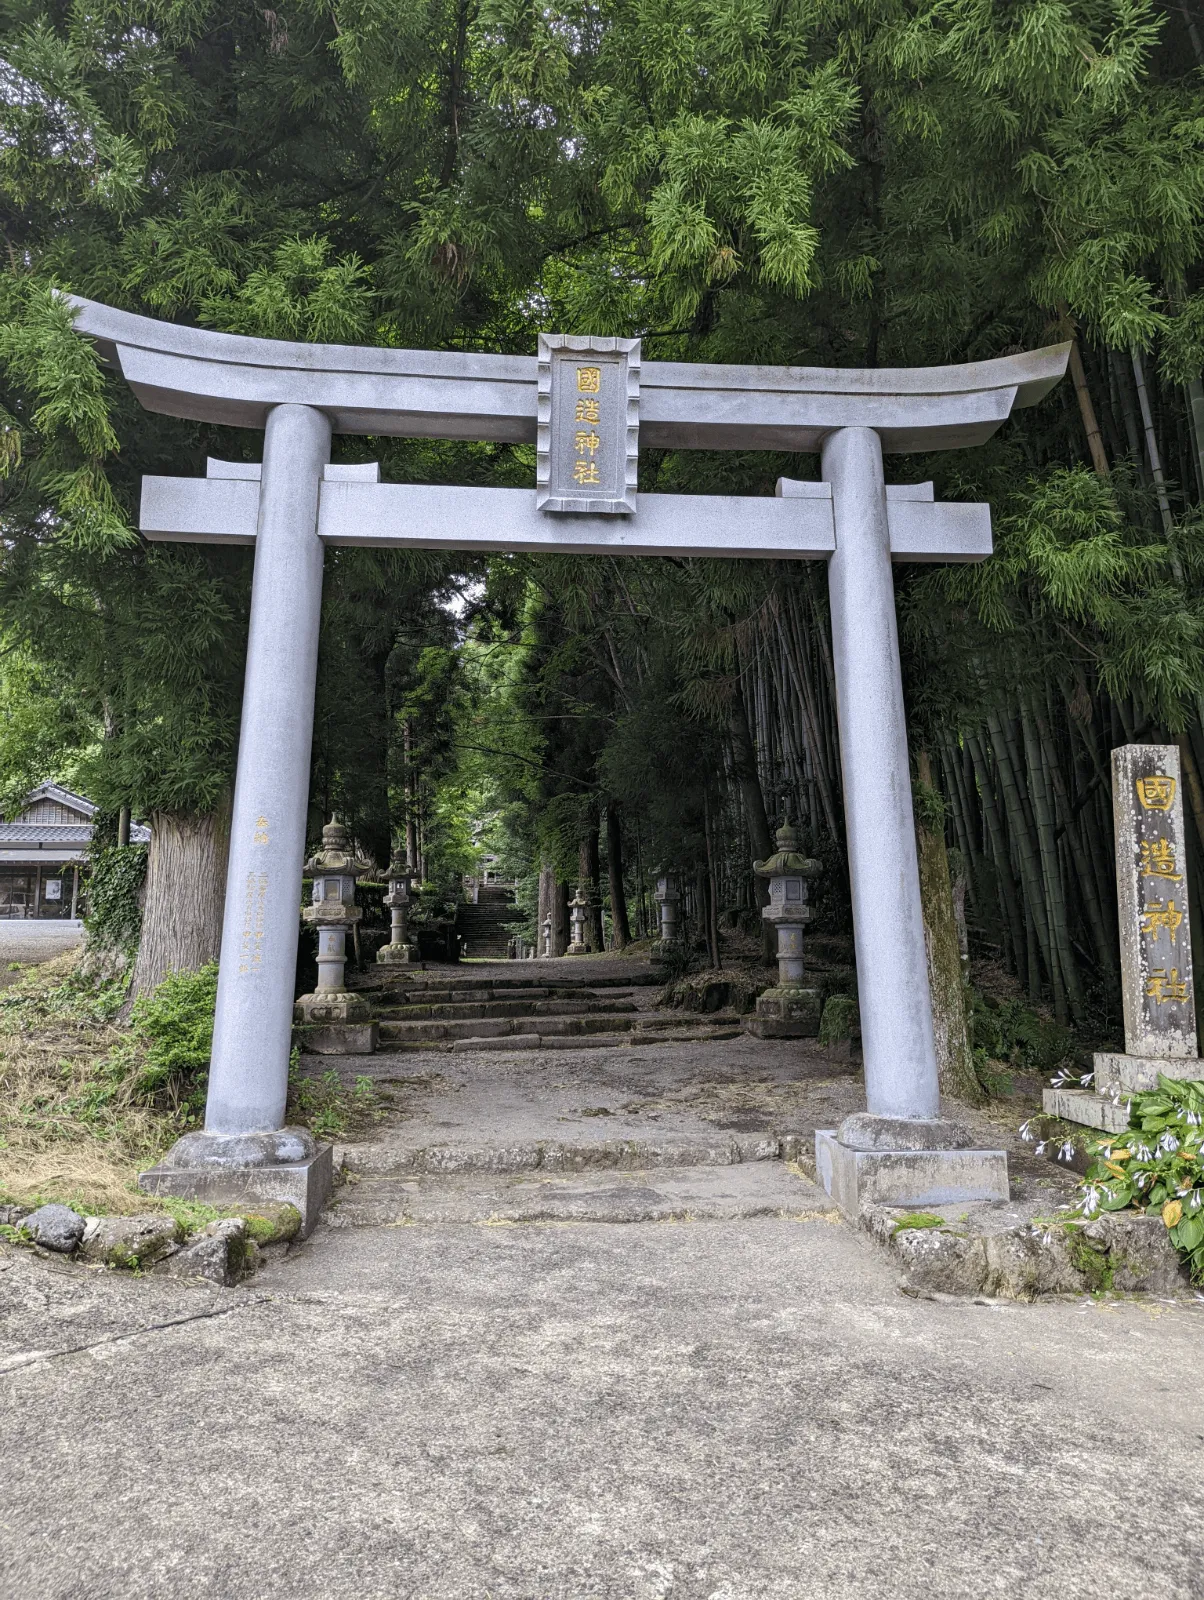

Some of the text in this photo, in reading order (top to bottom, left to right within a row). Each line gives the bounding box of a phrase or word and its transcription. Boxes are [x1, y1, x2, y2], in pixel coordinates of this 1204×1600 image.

[574, 366, 601, 485] 國造神社
[1136, 775, 1190, 1005] 國造神社
